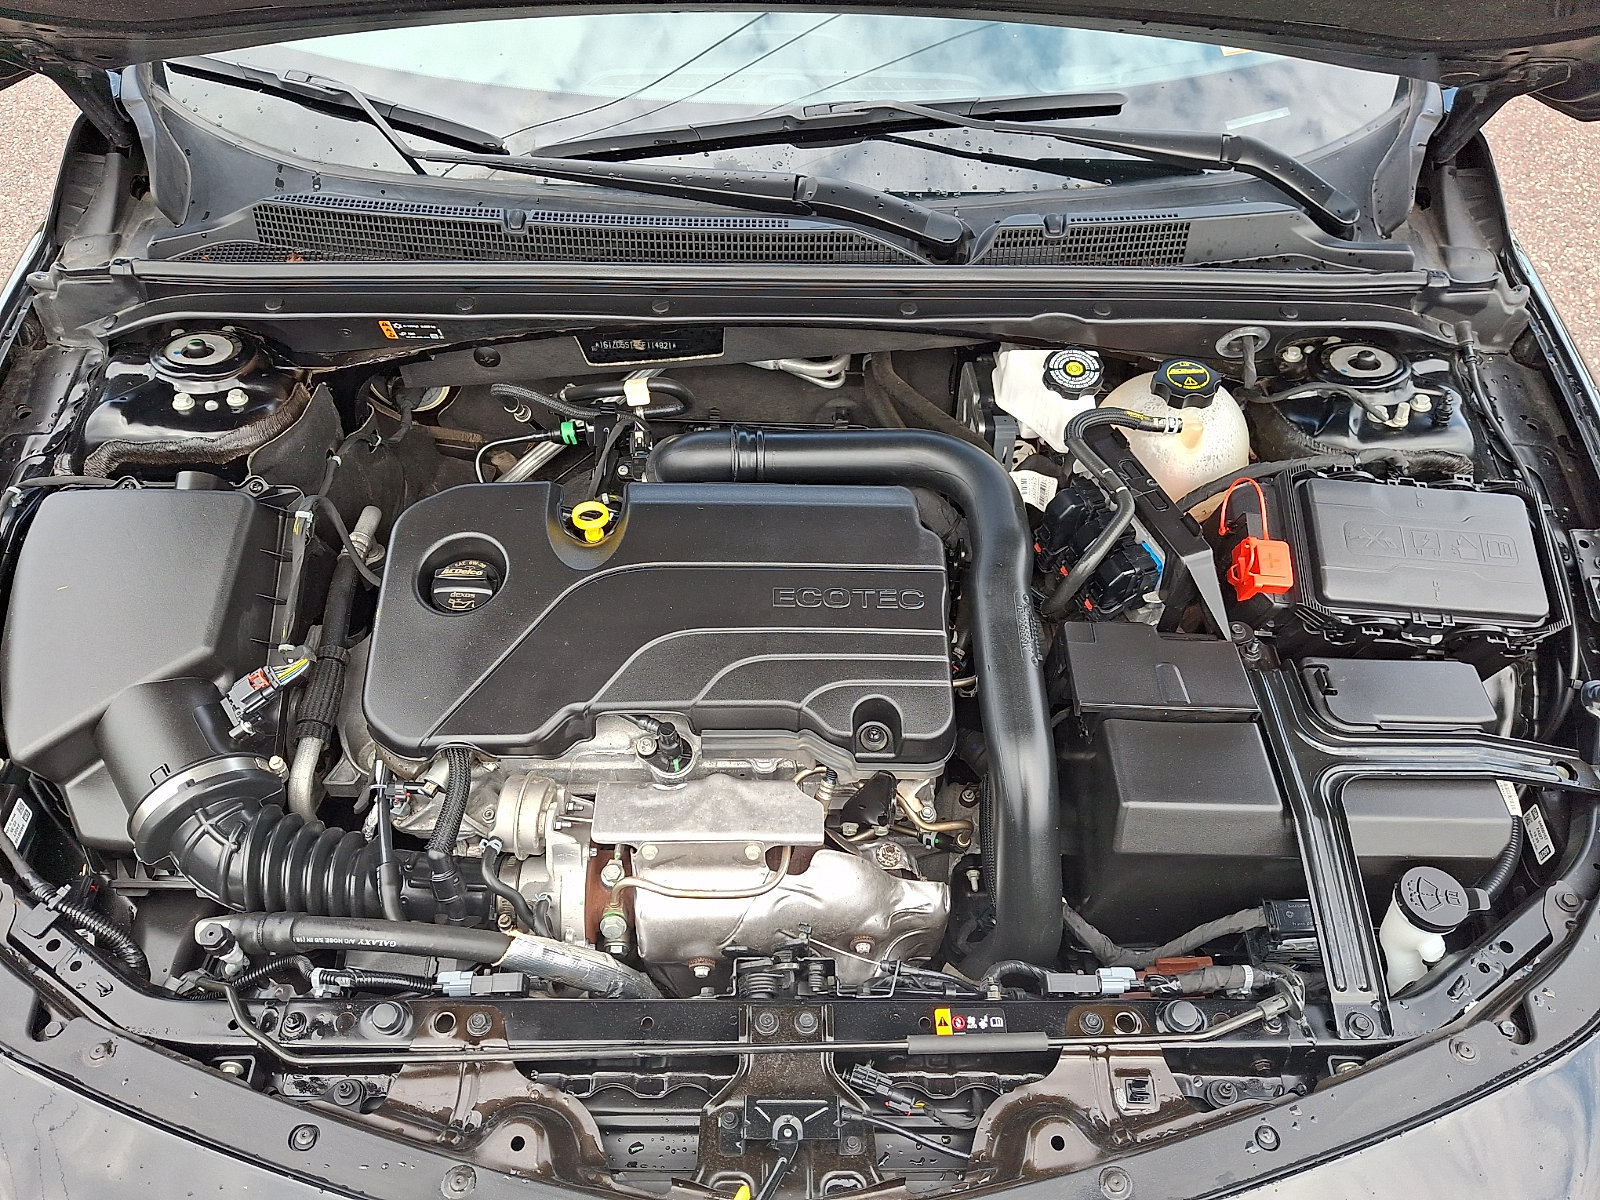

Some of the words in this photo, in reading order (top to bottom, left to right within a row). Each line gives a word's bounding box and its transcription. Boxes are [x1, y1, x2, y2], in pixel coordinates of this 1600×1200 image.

[441, 568, 484, 576] ACDelco
[772, 587, 925, 610] ECOTEC
[358, 938, 397, 947] GALAXY
